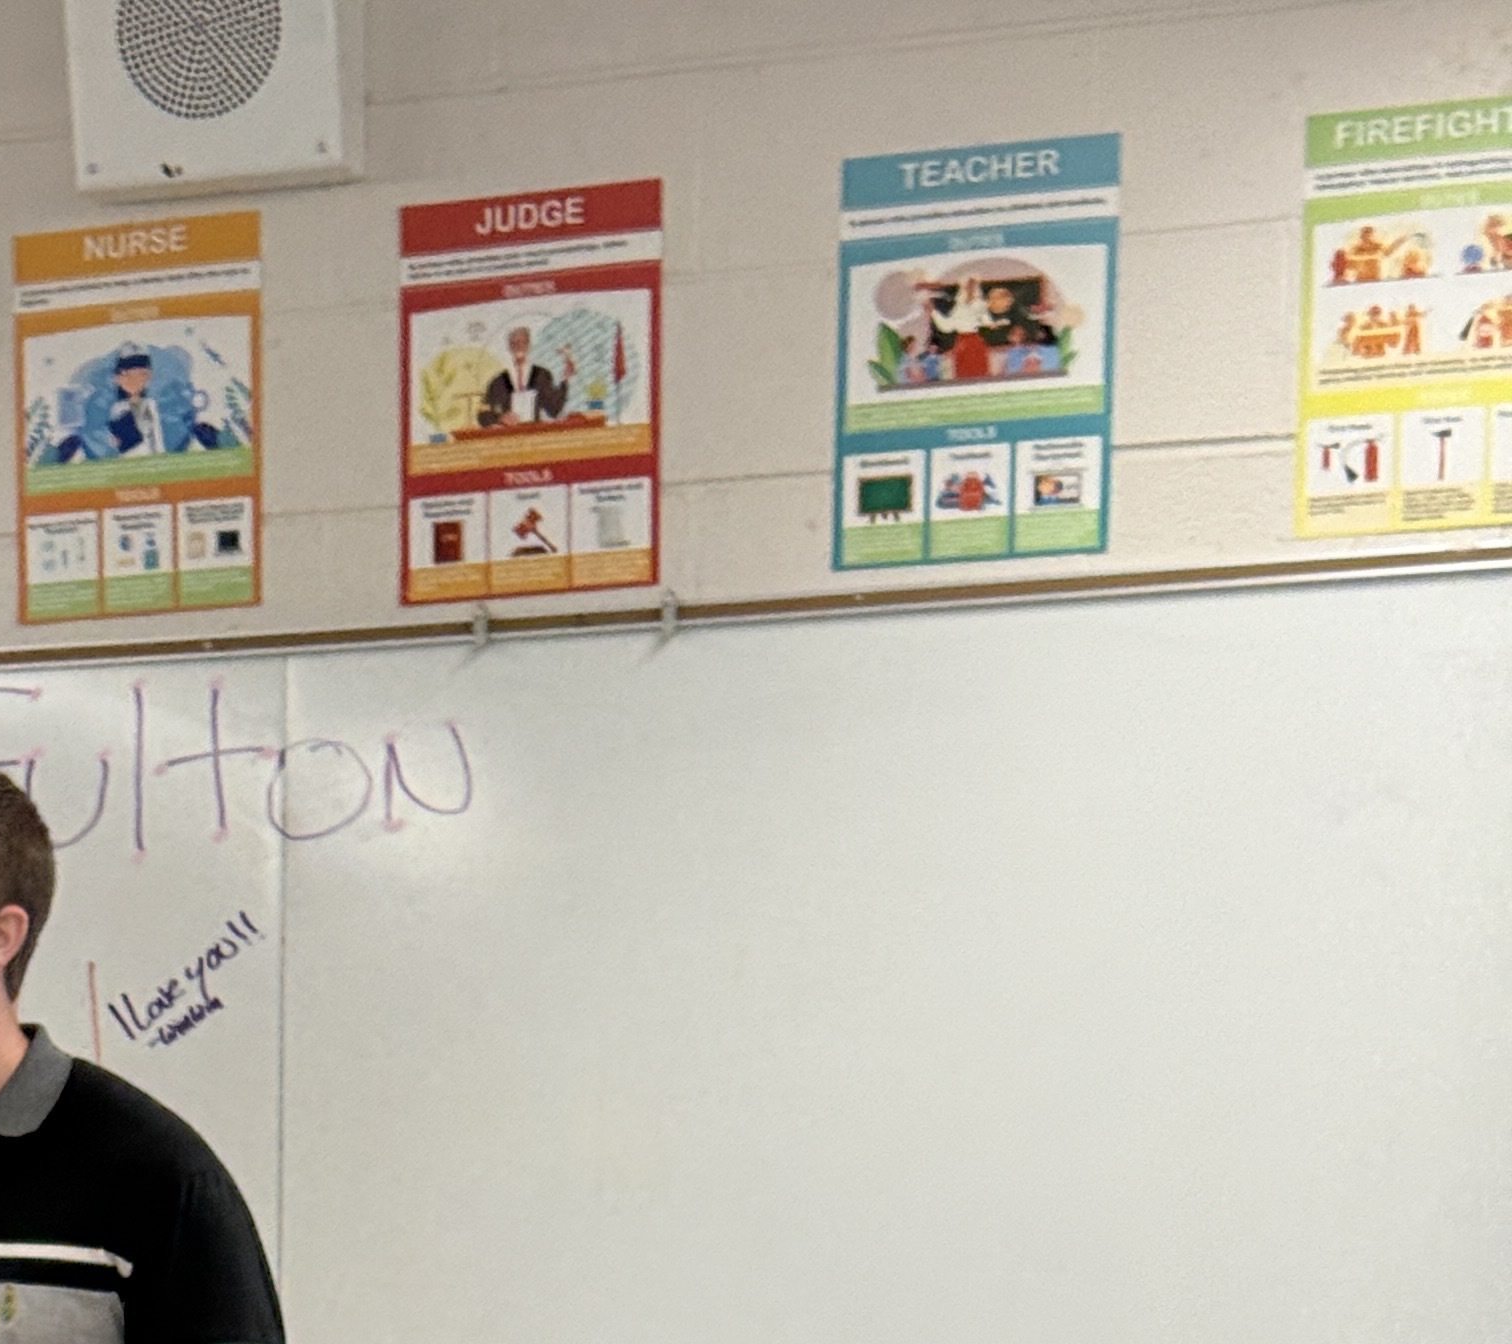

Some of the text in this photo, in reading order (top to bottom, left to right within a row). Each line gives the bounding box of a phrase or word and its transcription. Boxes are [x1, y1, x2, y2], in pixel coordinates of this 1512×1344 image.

[899, 149, 1060, 191] TEACHER
[474, 196, 585, 235] JUDGE
[82, 223, 188, 261] NURSE
